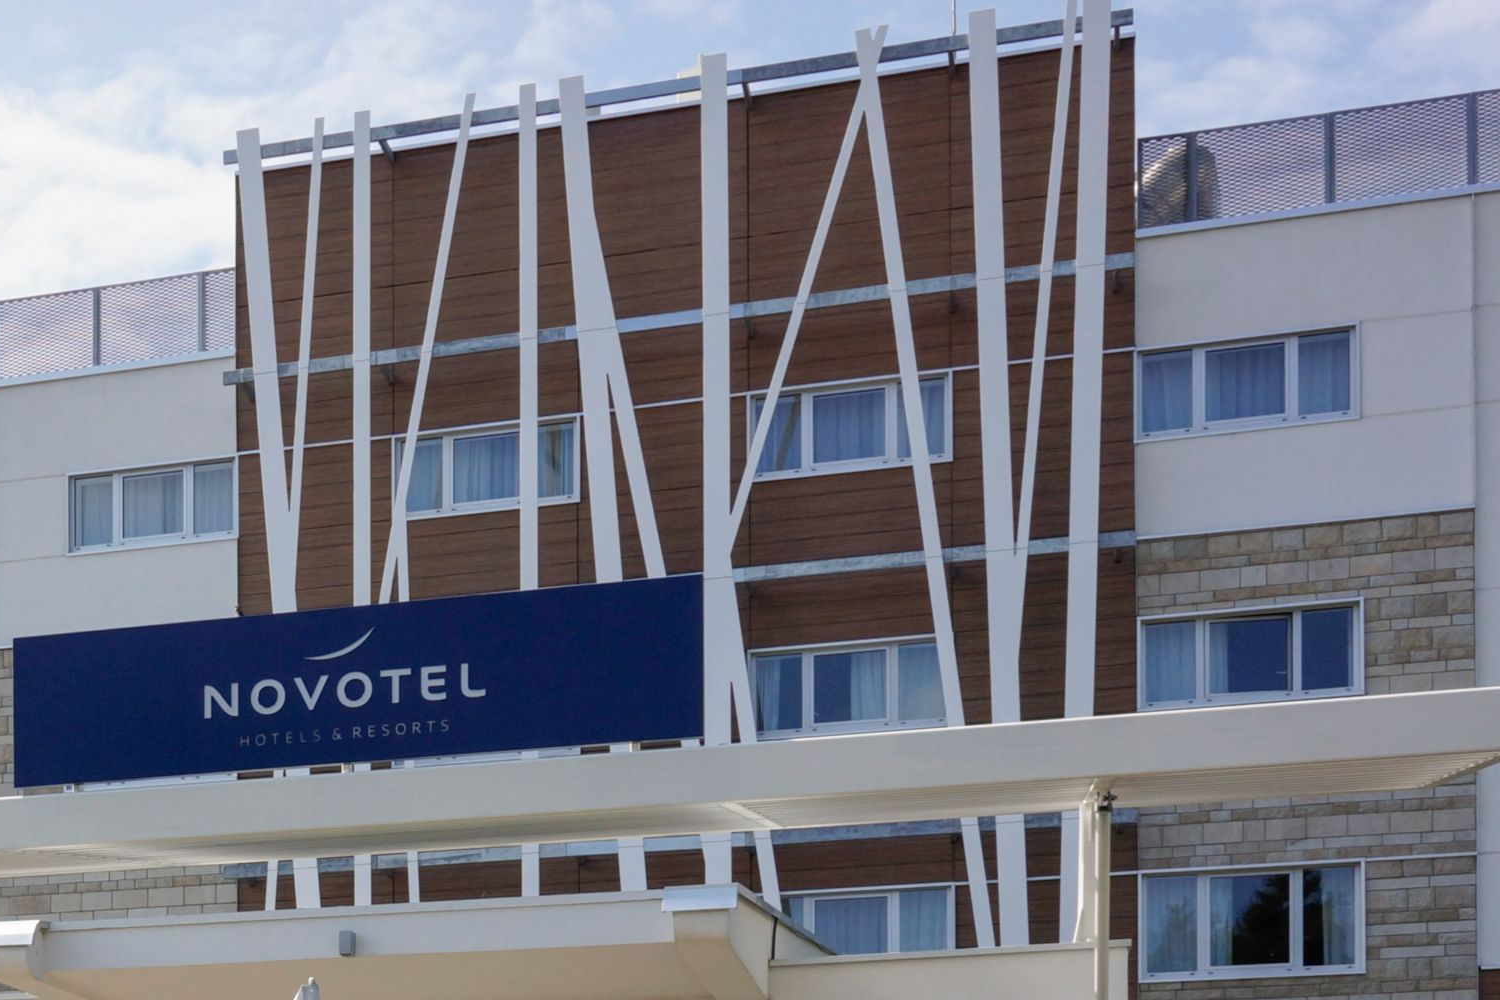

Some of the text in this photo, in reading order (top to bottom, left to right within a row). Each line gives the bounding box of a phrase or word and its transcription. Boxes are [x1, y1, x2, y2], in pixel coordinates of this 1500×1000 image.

[203, 662, 486, 719] NOVOTEL
[239, 718, 450, 747] HOTELS & RESORTS
